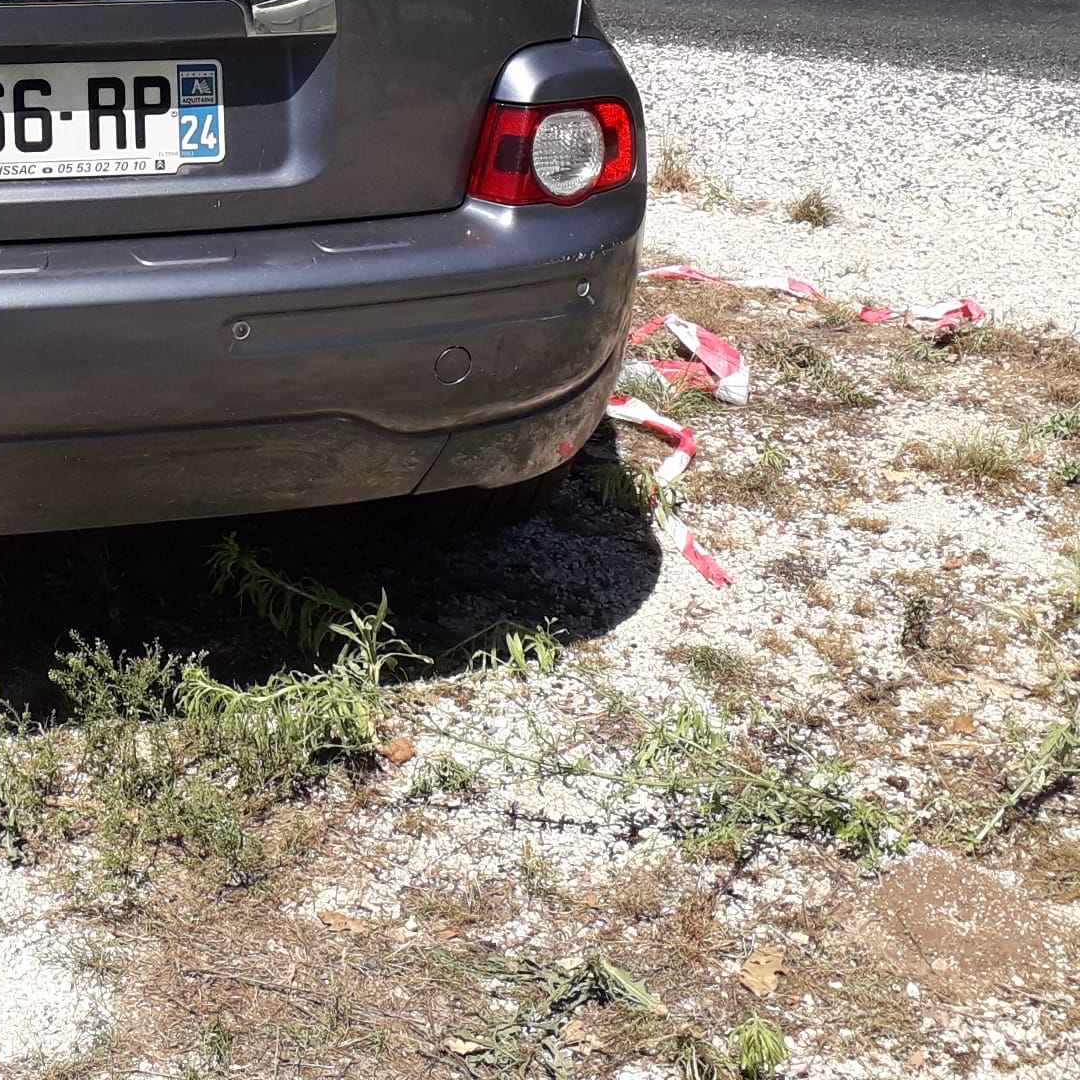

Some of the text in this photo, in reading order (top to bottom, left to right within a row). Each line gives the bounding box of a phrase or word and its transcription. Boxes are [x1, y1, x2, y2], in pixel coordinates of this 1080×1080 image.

[180, 114, 217, 150] 24
[57, 163, 73, 174] 05
[76, 162, 92, 173] 53
[94, 162, 110, 173] 02
[114, 161, 129, 172] 70
[133, 160, 147, 171] 10
